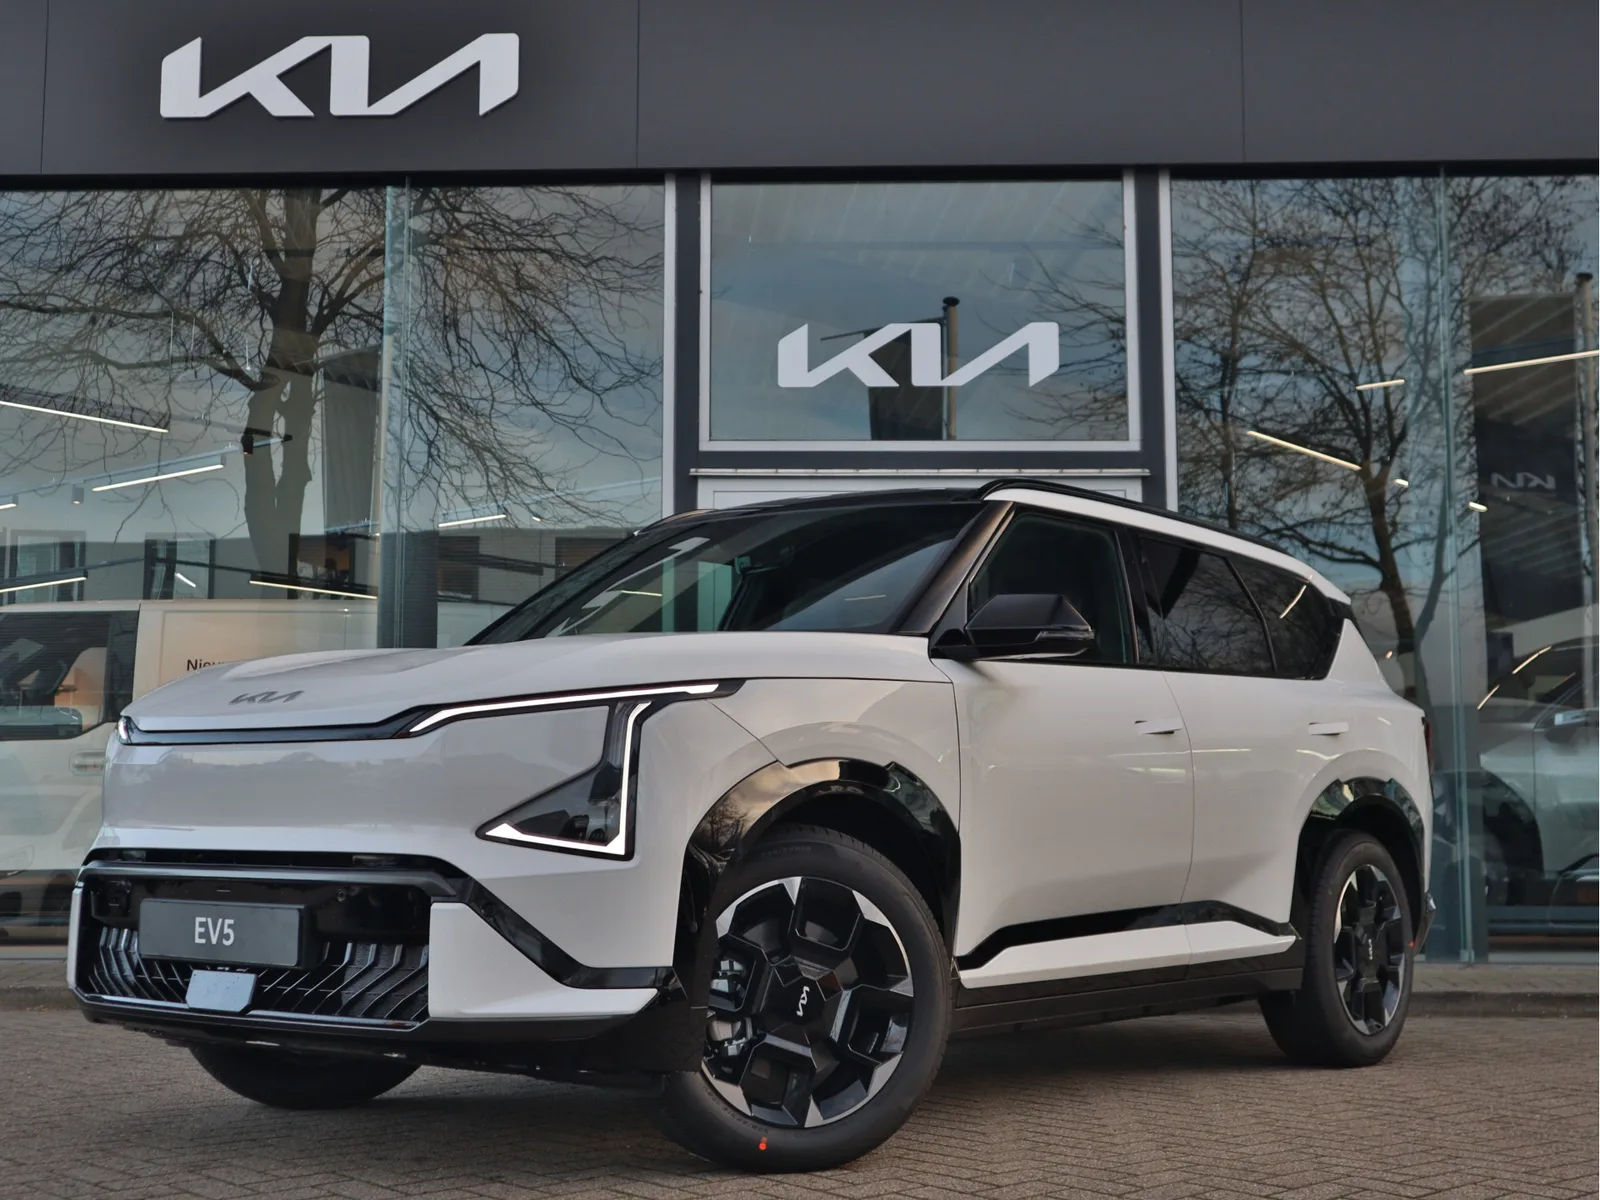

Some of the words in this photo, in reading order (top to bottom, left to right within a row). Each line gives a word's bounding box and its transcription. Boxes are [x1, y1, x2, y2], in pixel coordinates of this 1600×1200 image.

[160, 33, 519, 118] KIA
[778, 322, 1059, 387] KIA
[228, 690, 304, 705] KIA
[195, 917, 235, 946] EV5
